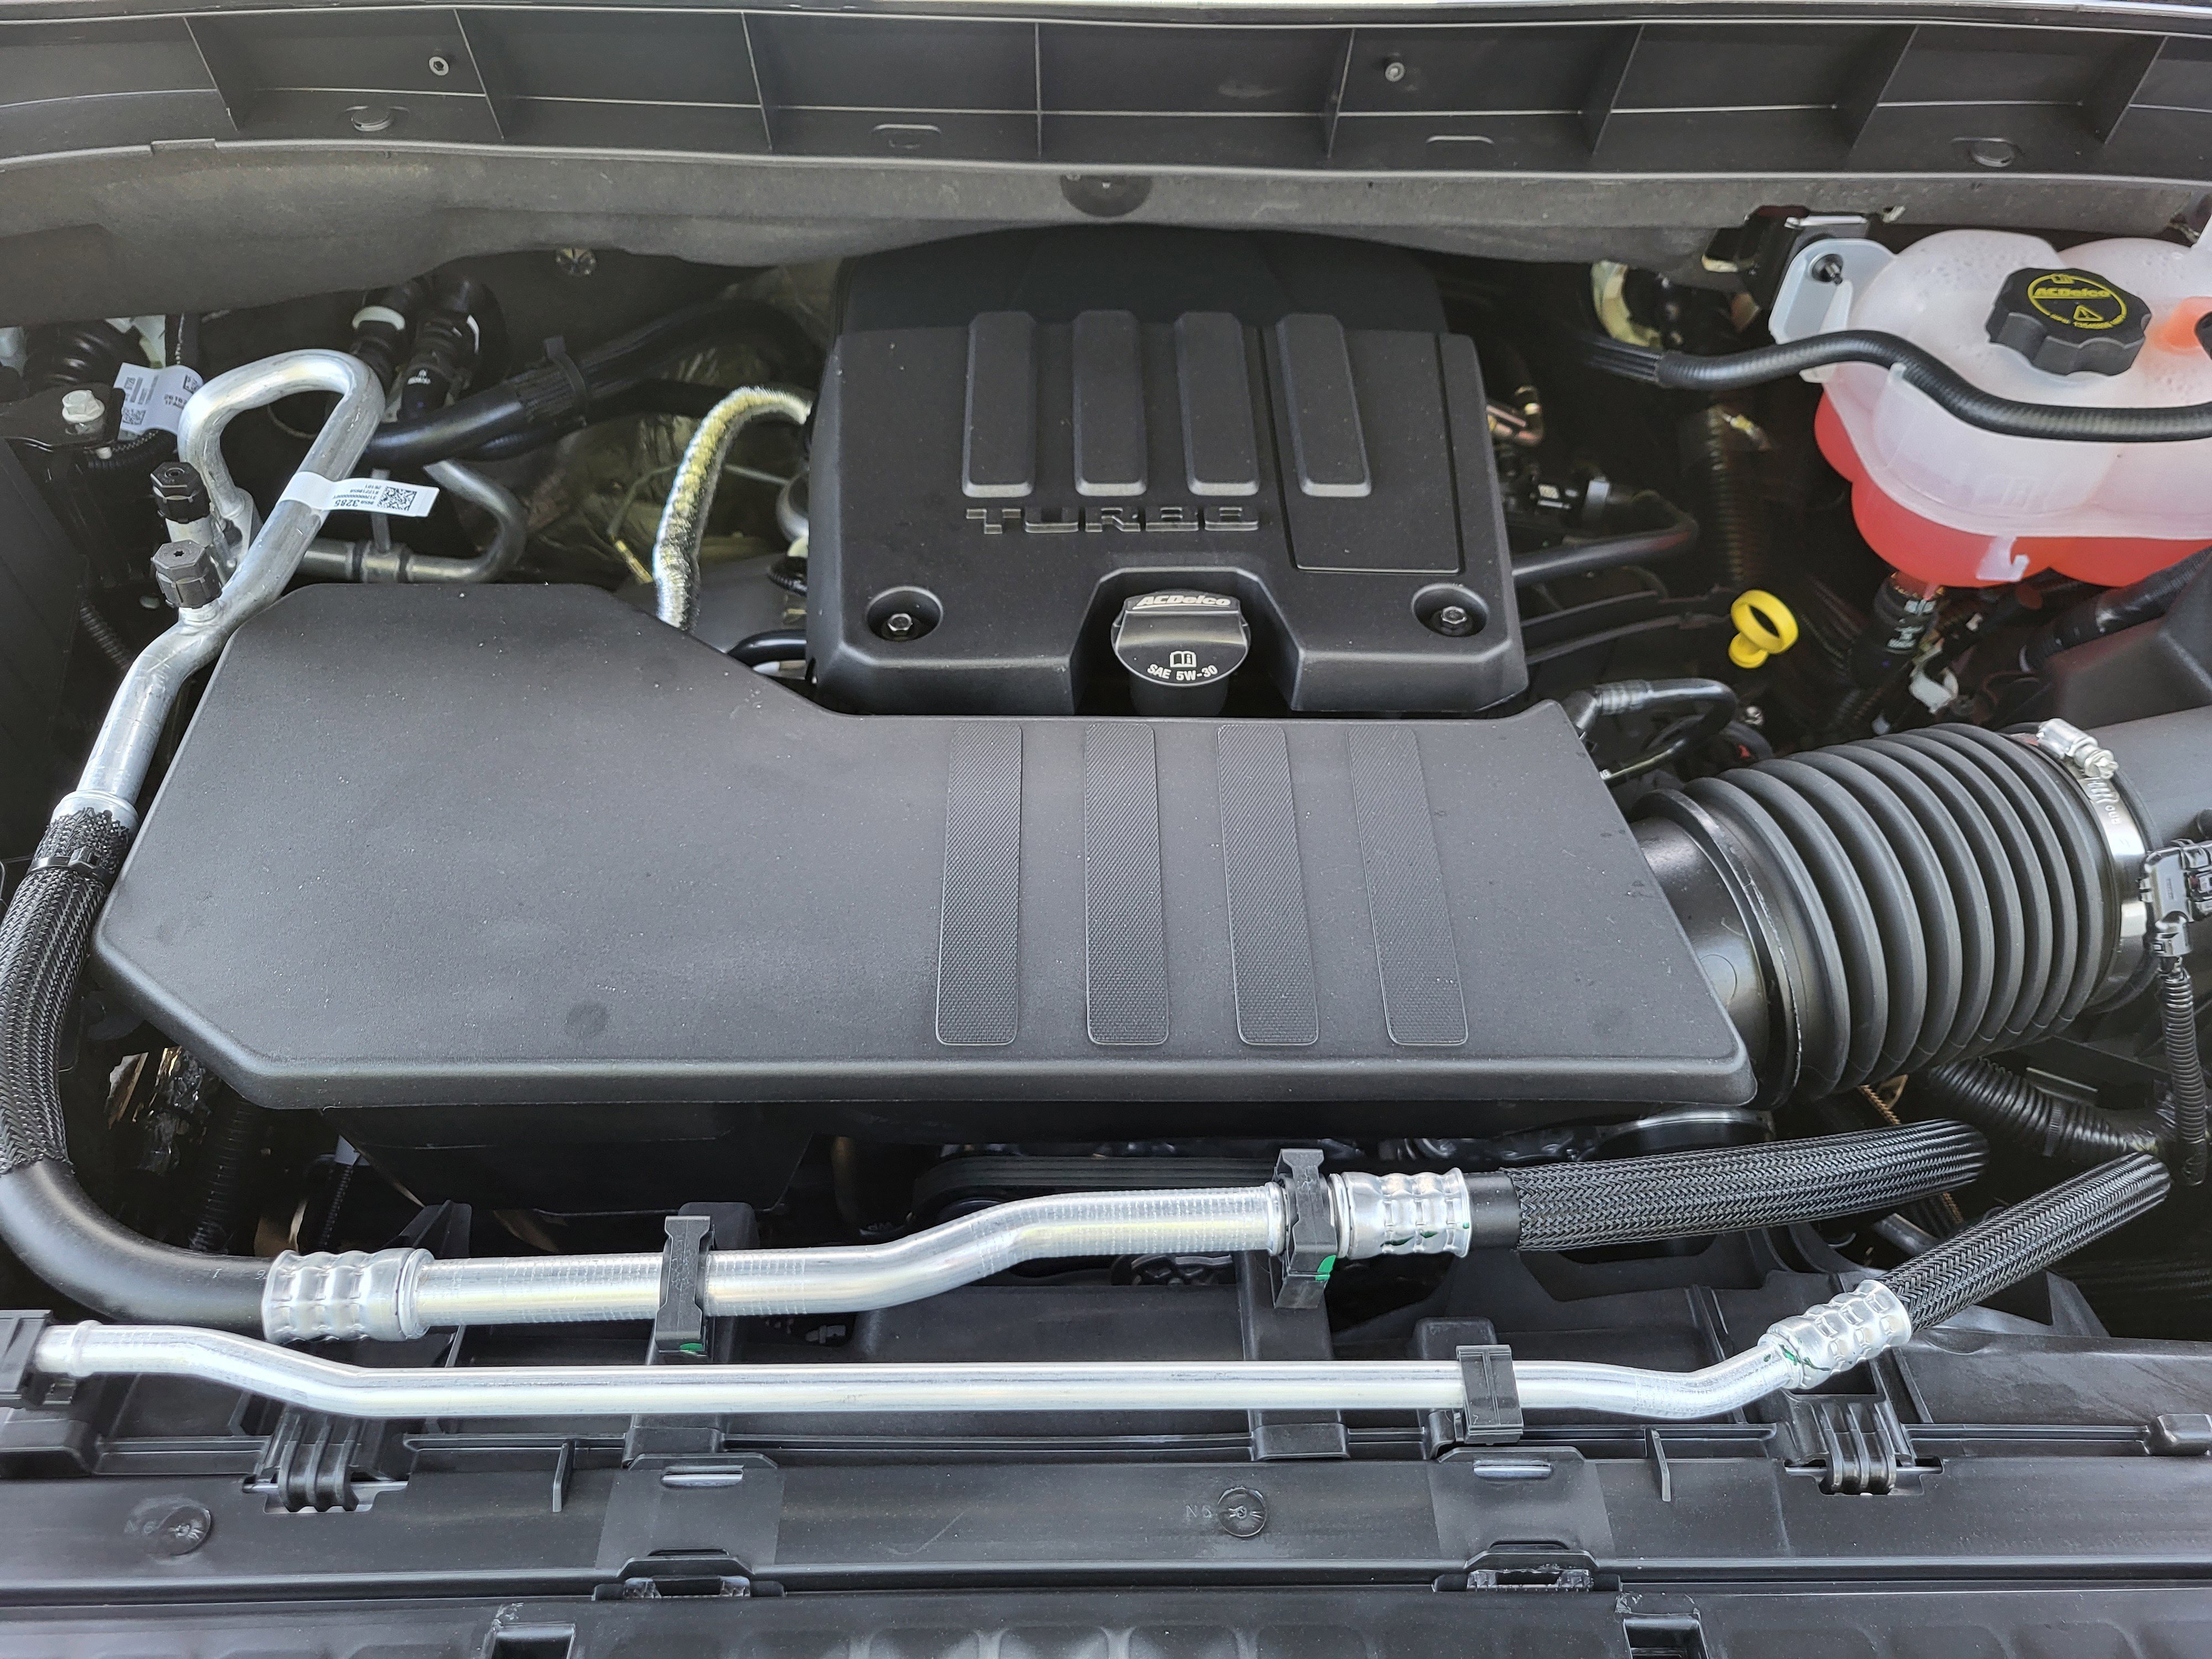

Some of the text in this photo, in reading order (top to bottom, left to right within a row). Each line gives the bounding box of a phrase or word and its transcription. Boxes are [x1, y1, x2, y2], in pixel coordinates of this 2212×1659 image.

[2033, 286, 2111, 298] ACDelco
[966, 504, 1260, 535] TURBO
[1136, 594, 1231, 607] ACDelco
[1147, 664, 1218, 681] SAE 5W-30
